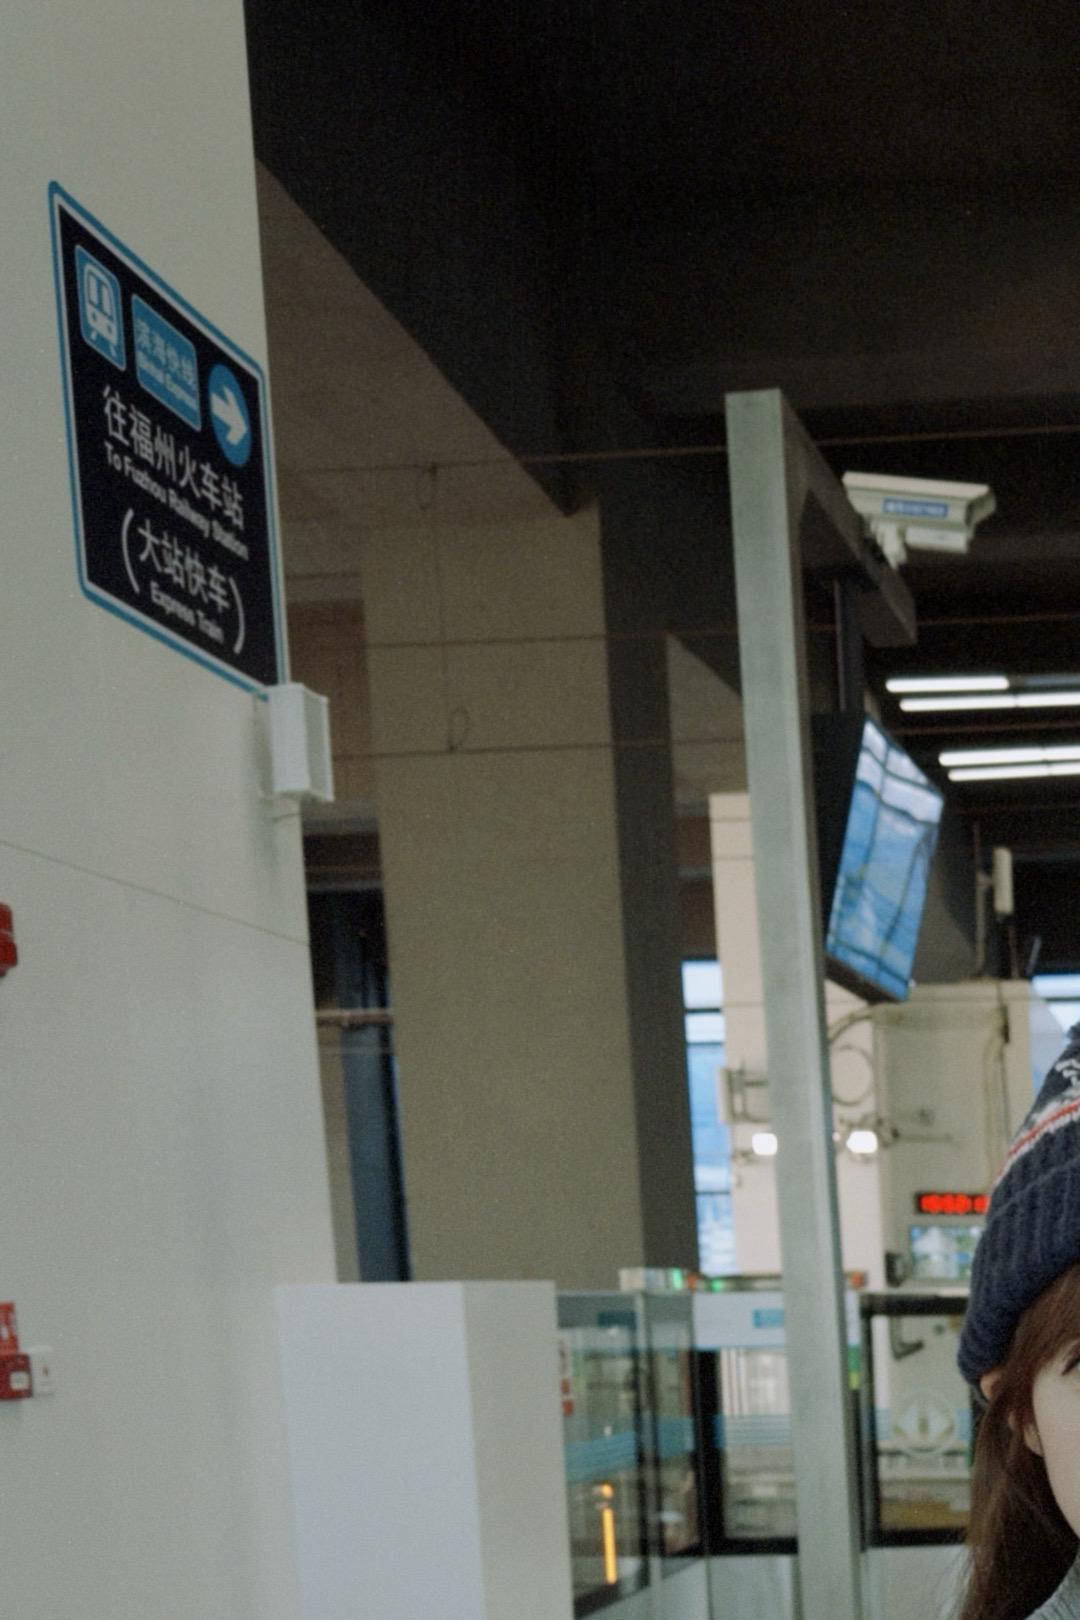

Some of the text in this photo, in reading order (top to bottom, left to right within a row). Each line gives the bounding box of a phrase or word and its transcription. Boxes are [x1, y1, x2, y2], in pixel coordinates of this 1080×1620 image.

[103, 384, 245, 531] 往福州火车站
[104, 440, 123, 473] To
[124, 461, 166, 505] Fuzhou
